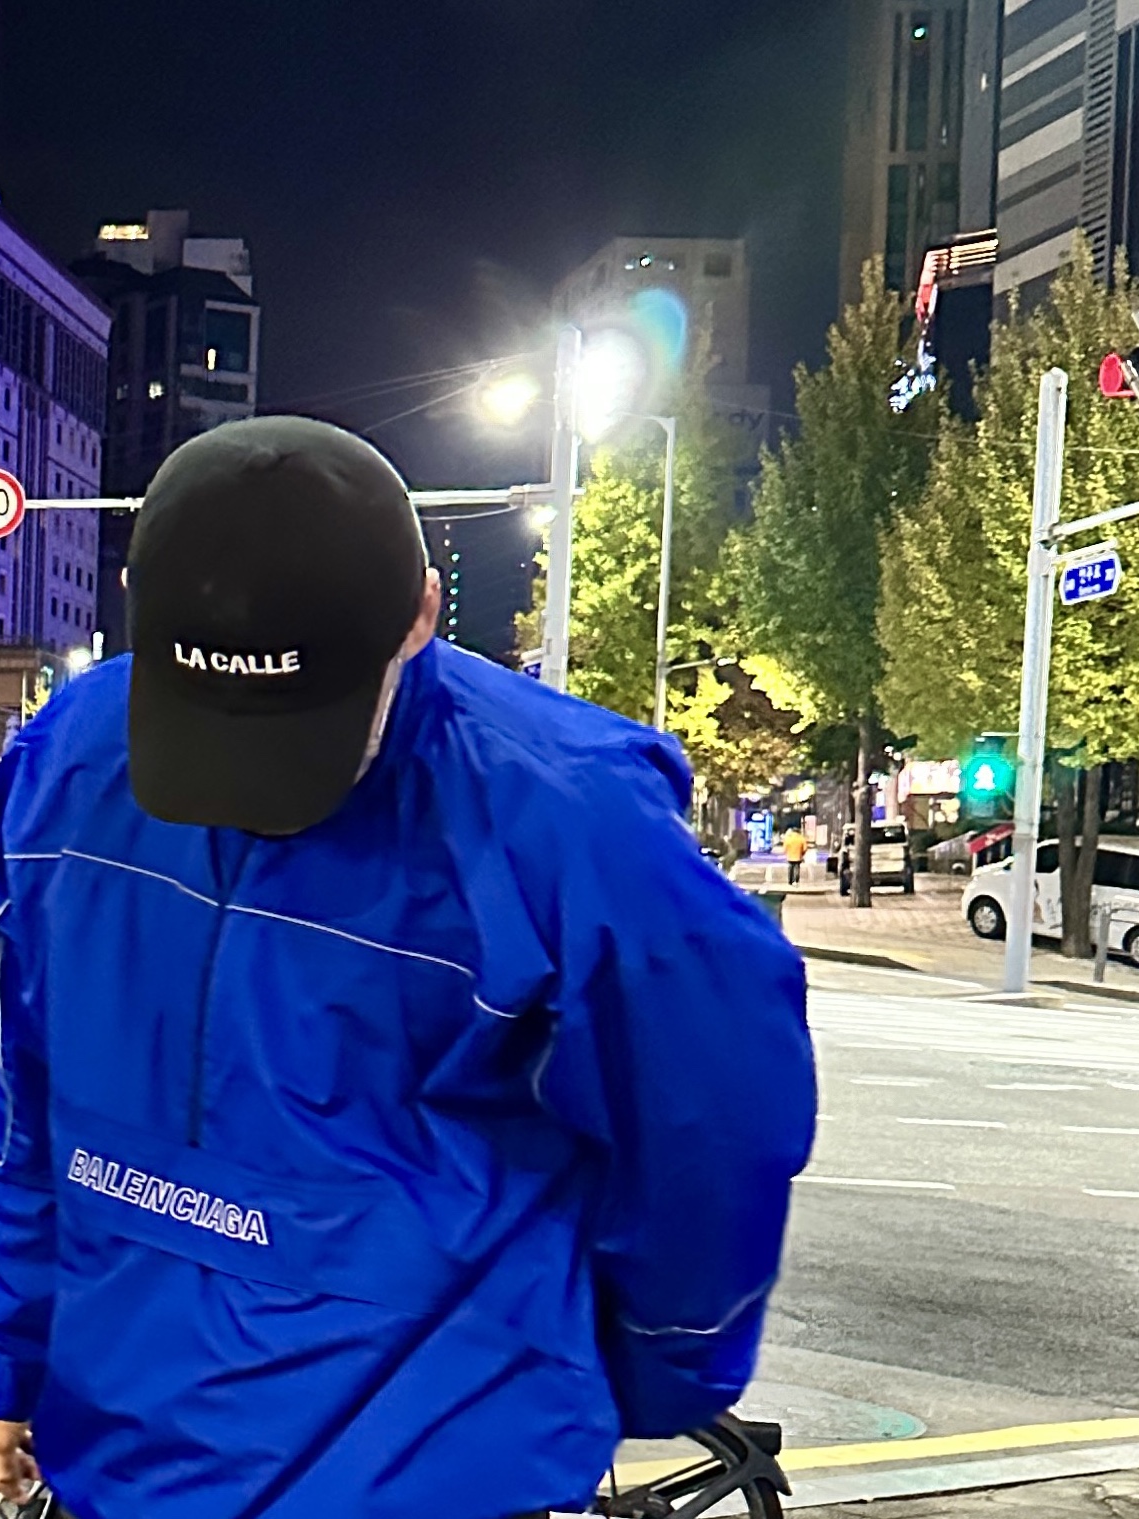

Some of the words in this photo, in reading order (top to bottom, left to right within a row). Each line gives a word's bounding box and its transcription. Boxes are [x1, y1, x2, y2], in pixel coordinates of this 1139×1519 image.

[174, 642, 208, 671] LA
[210, 650, 301, 675] CALLE
[67, 1148, 270, 1246] BALENCIAGA
